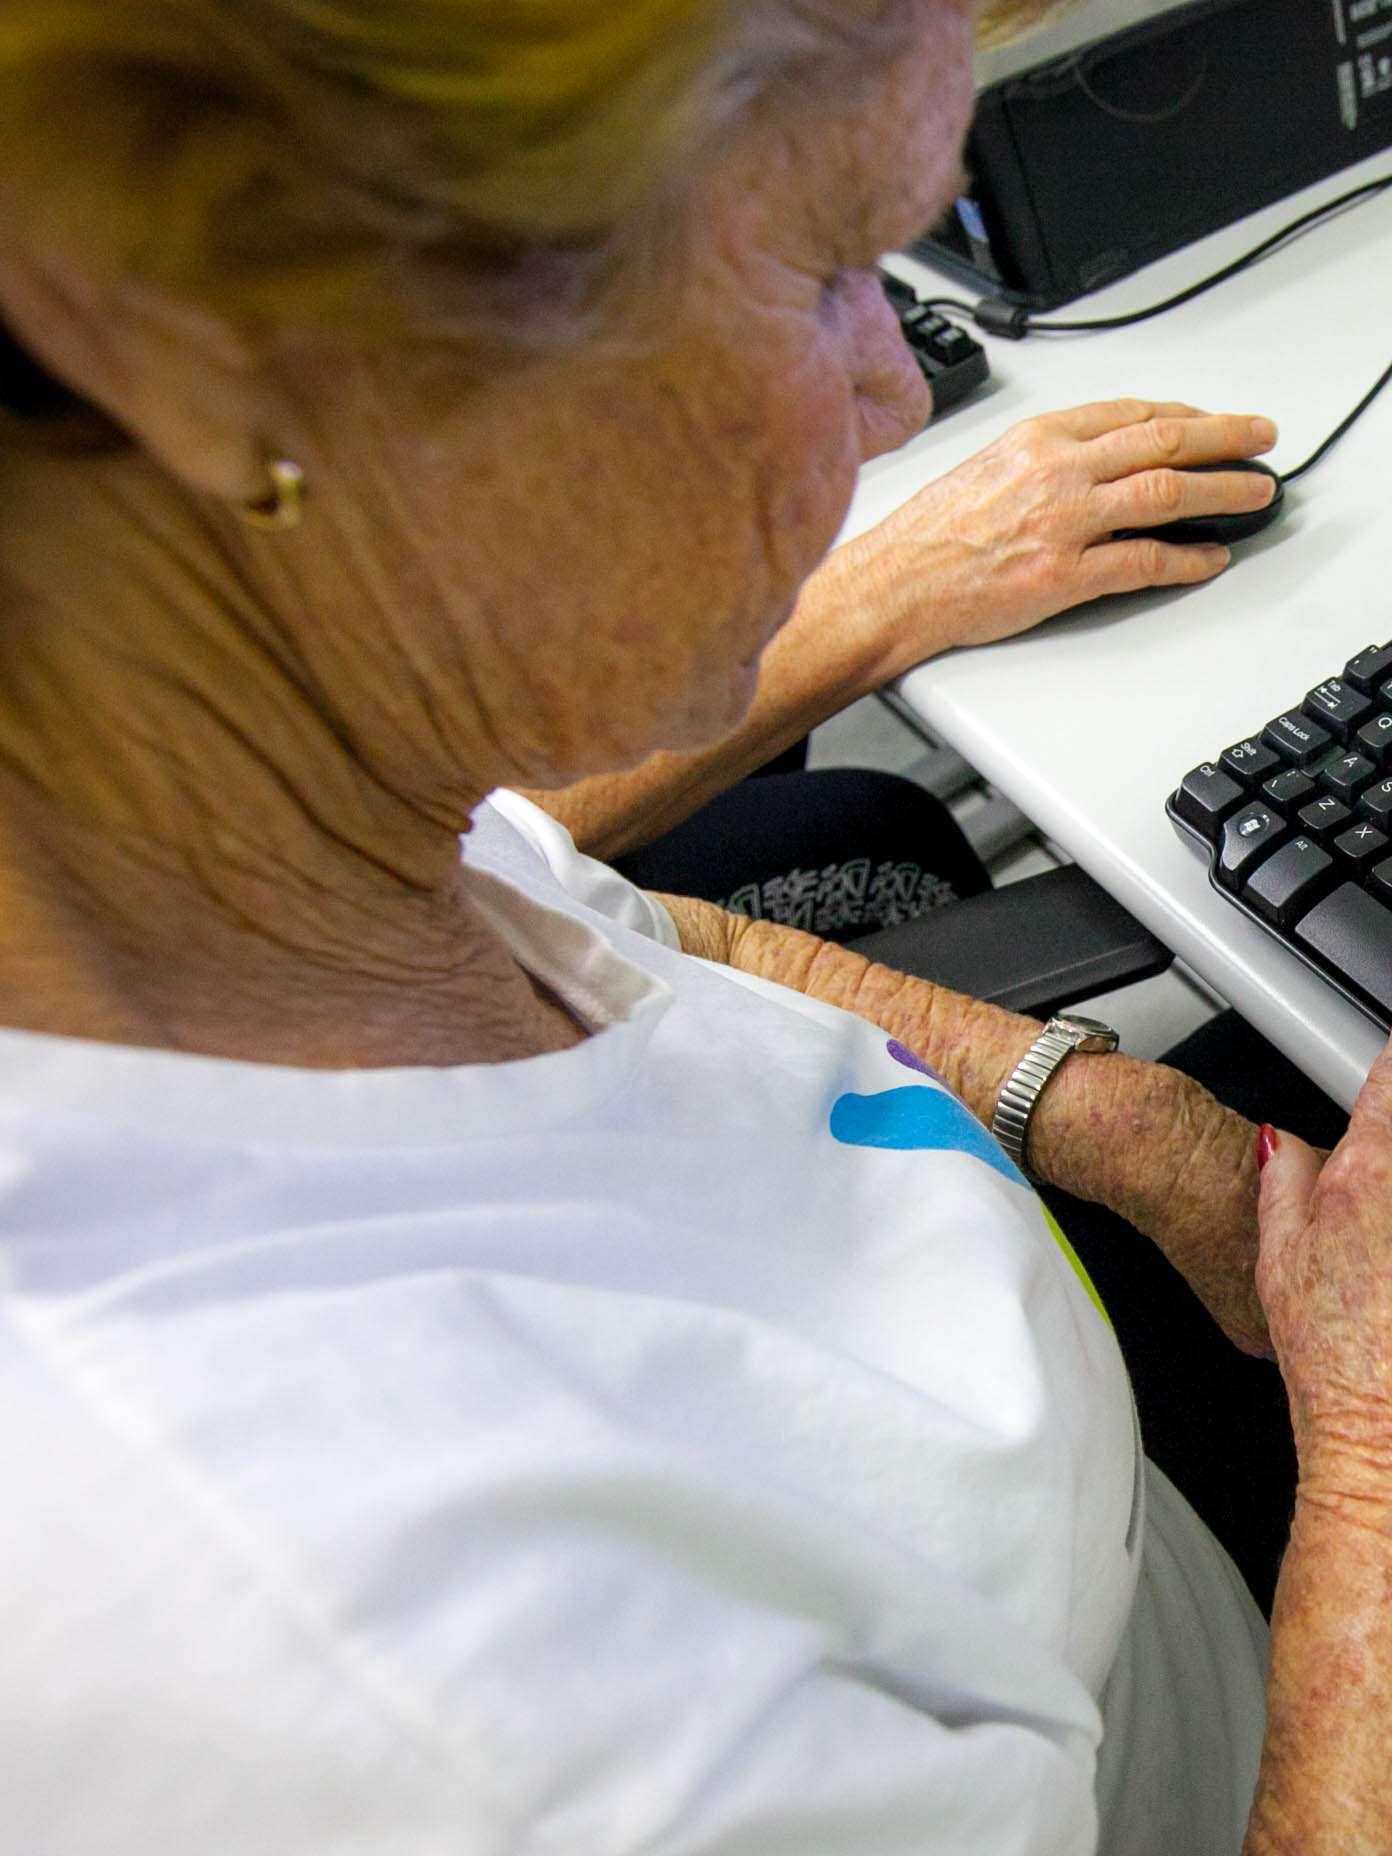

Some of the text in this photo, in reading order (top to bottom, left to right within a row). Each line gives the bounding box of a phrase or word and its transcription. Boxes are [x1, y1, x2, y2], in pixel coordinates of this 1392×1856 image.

[1328, 680, 1341, 692] Tab
[1278, 716, 1295, 731] Caps
[1378, 717, 1392, 729] Q
[1344, 757, 1358, 767] A
[1319, 799, 1335, 810] Z
[1355, 826, 1373, 838] X
